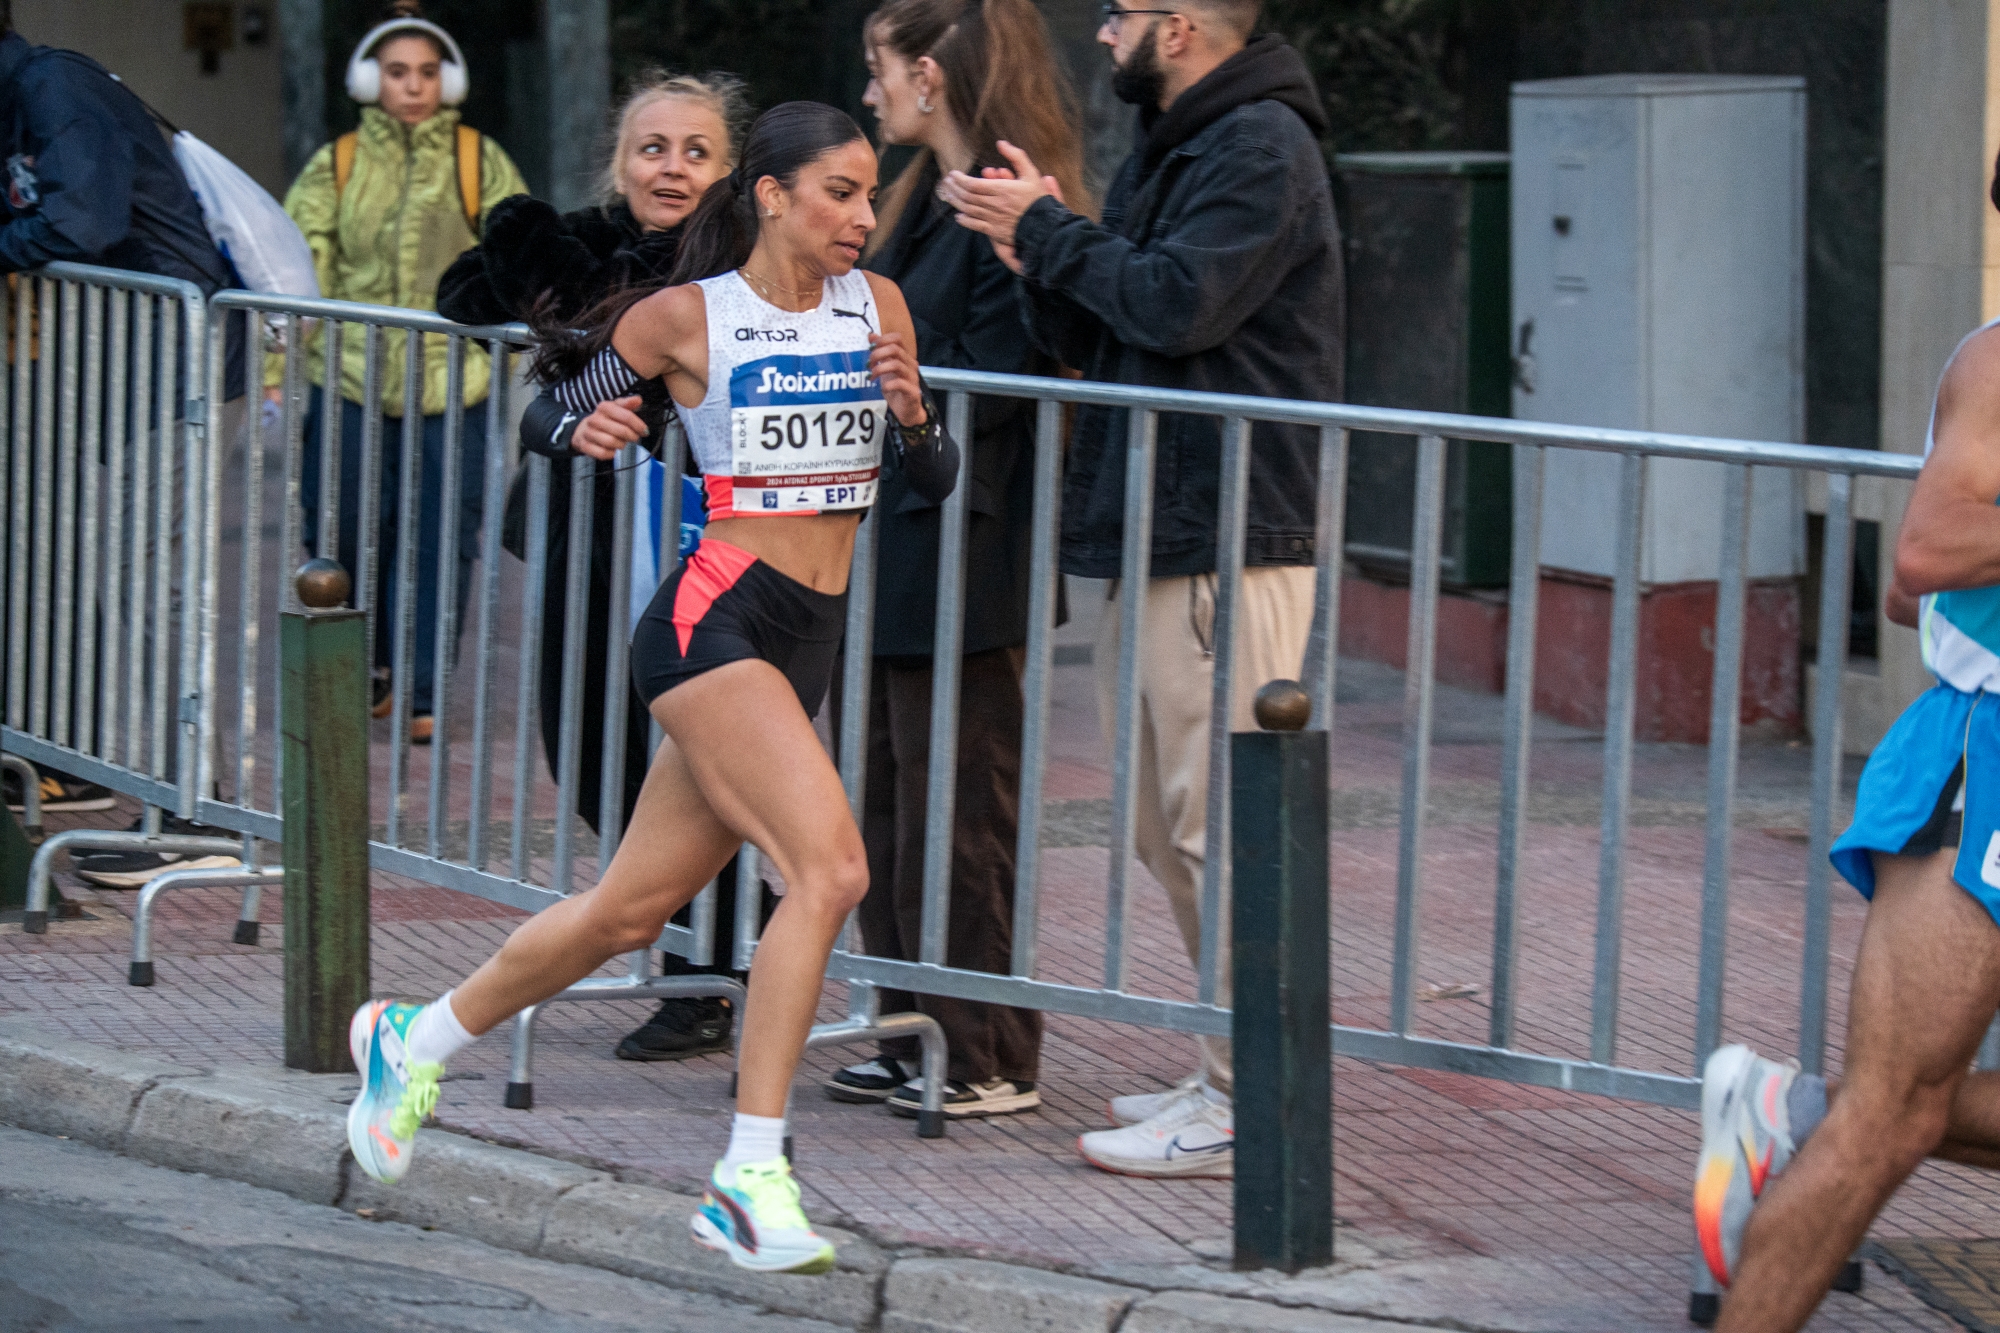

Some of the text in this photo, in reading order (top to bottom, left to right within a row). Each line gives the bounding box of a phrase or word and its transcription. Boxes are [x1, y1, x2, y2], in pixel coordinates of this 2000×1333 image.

[760, 407, 875, 451] 50129
[754, 463, 782, 472] ΑΝΘΗ
[766, 477, 783, 486] 2024
